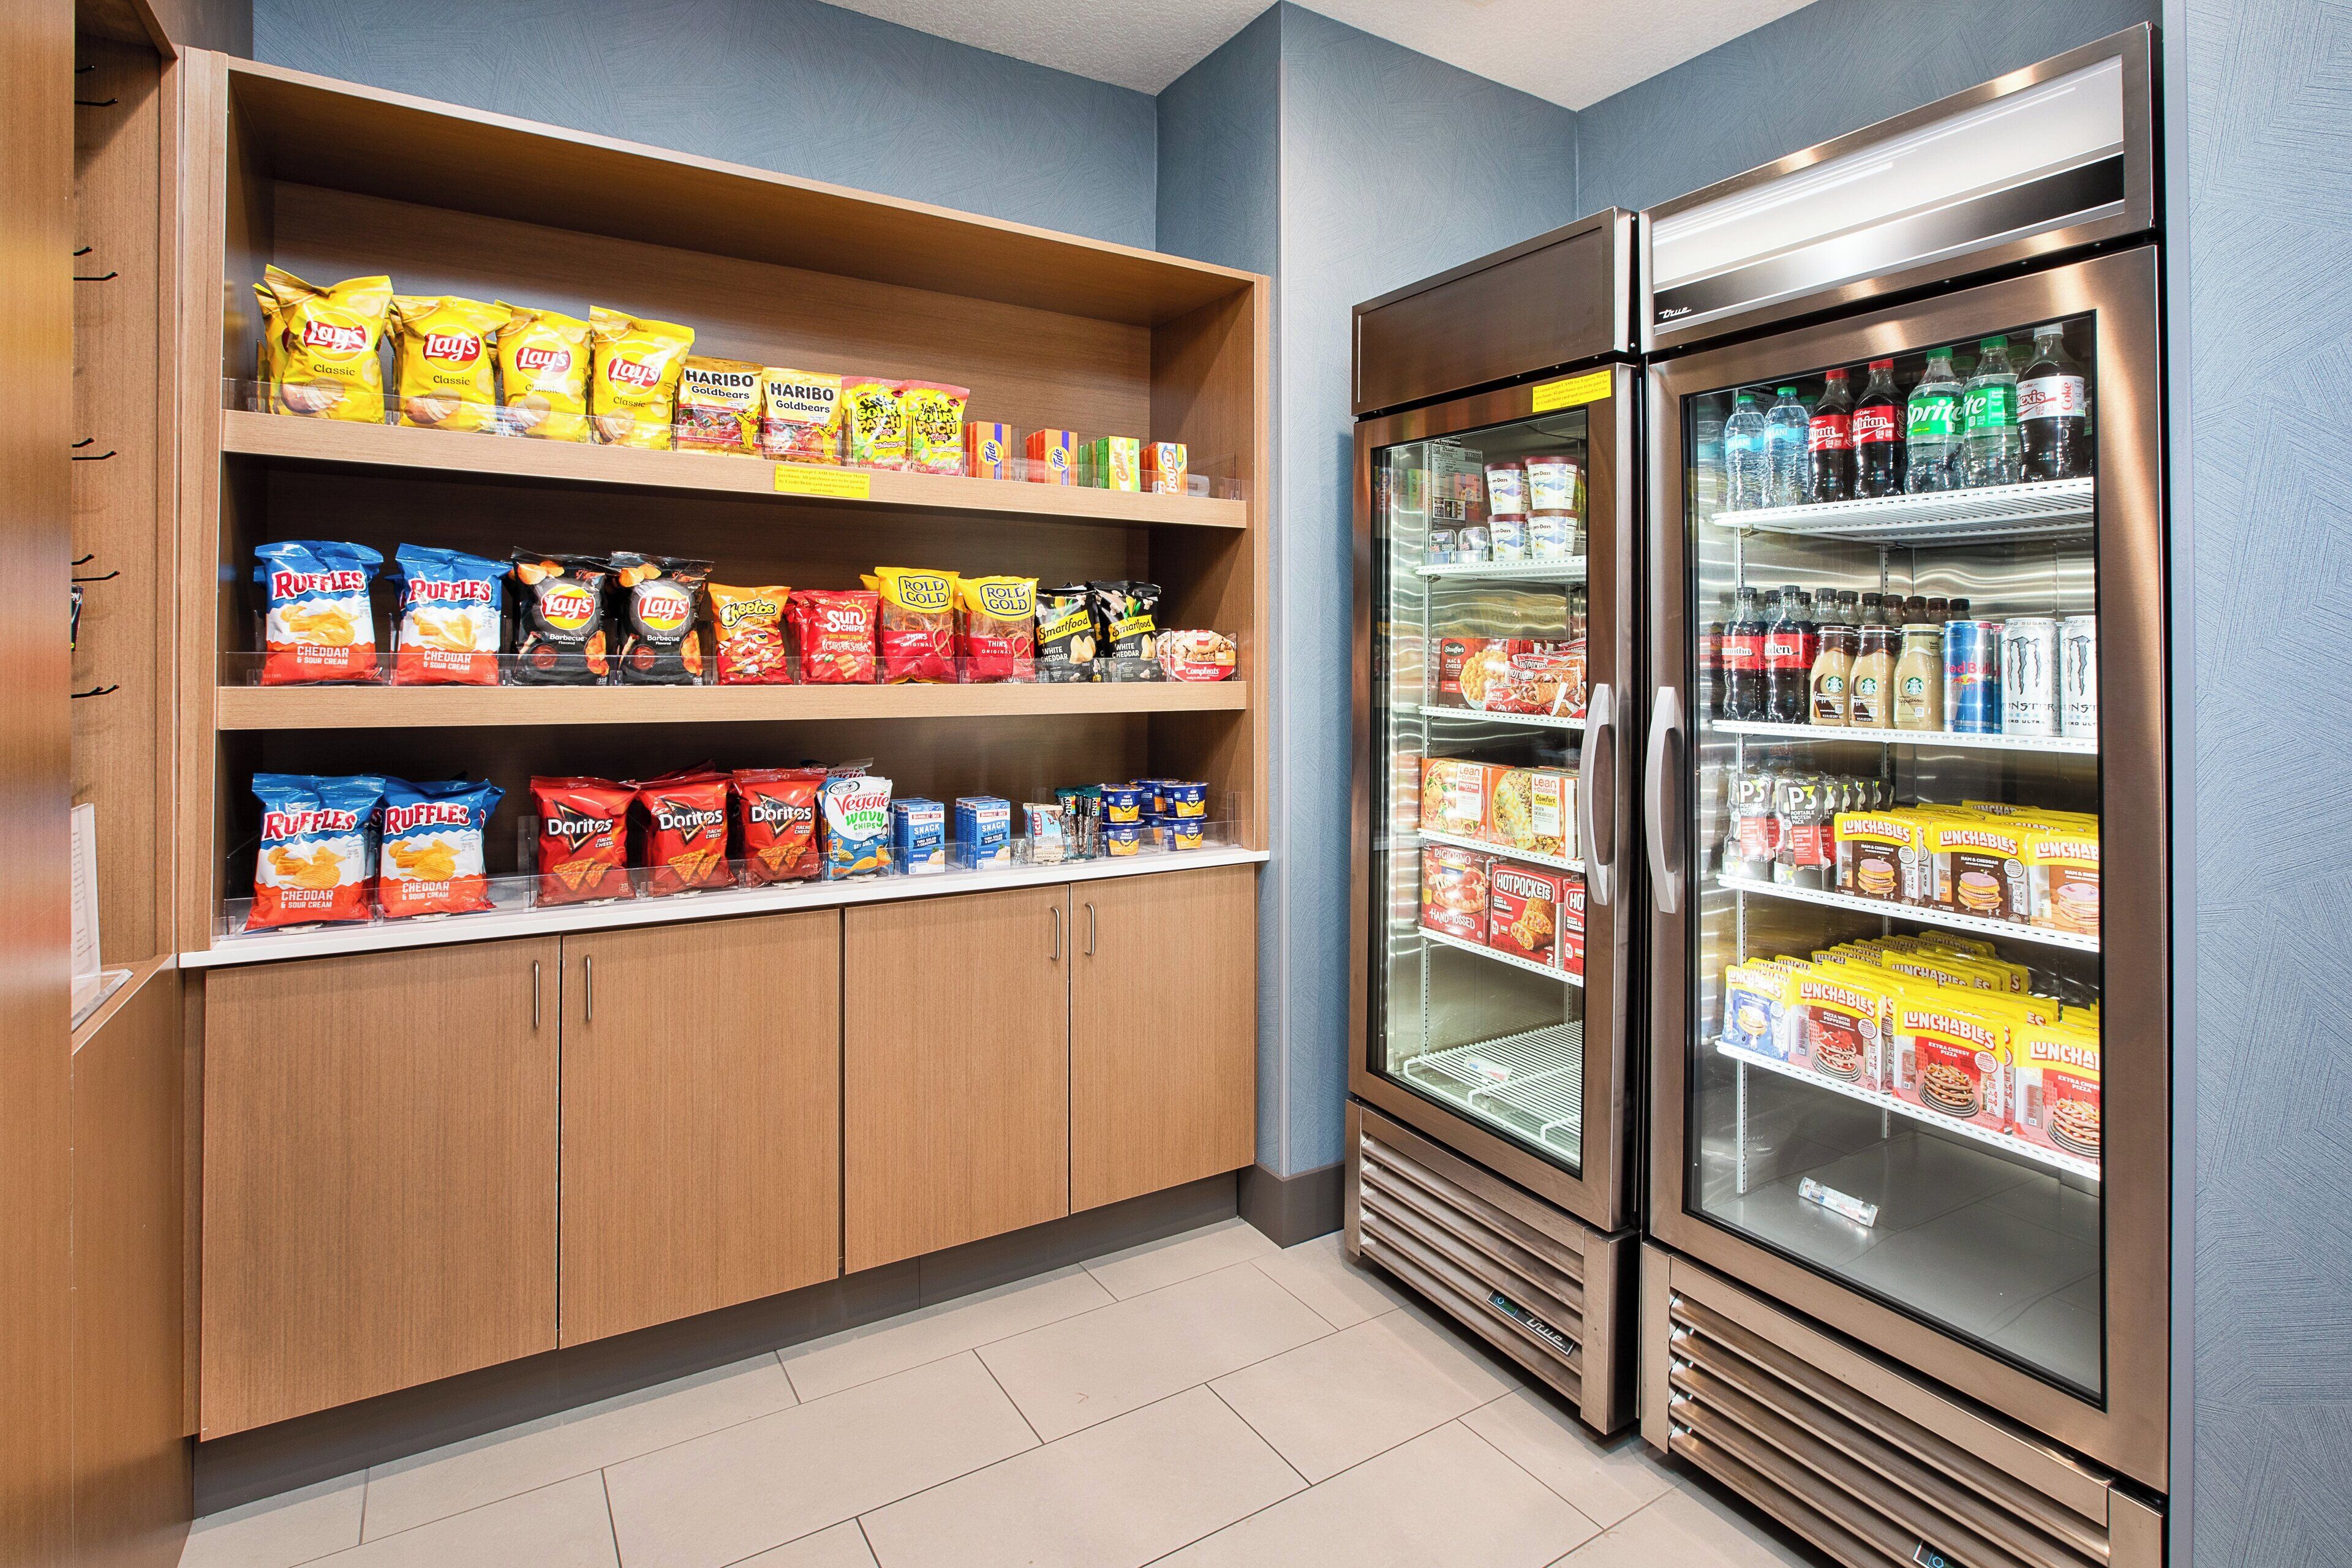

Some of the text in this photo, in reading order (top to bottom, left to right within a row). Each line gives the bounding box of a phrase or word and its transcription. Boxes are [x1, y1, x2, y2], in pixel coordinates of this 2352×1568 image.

[307, 321, 364, 350] Lay's
[426, 333, 477, 361] Lay's
[519, 347, 570, 372] Lay's
[314, 364, 355, 377] Classic
[433, 375, 470, 386] Classic
[686, 370, 754, 387] HARIBO
[525, 383, 561, 394] Classic
[692, 385, 750, 399] Goldbears
[771, 383, 834, 401] HARIBO
[613, 396, 646, 407] Classic
[2061, 382, 2072, 410] Coke
[776, 400, 830, 413] Goldbears
[857, 405, 897, 421] SOUR
[1908, 399, 1962, 427] Sprite
[918, 412, 955, 423] SOUR
[858, 417, 901, 434] PATCH
[916, 421, 957, 434] PATCH
[985, 441, 1000, 462] Tide
[1054, 448, 1066, 470] Tide
[1114, 451, 1129, 481] GAIN
[275, 571, 366, 598] RUFFLES
[410, 579, 491, 601] RUFFLES
[905, 579, 944, 592] ROLD
[906, 591, 946, 604] GOLD
[987, 586, 1025, 599] ROLD
[547, 596, 592, 619] Lay's
[642, 594, 688, 620] Lay's
[989, 598, 1028, 611] GOLD
[720, 599, 776, 627] Cheetos
[826, 610, 867, 632] Sun
[1039, 617, 1088, 641] Smartfood
[1112, 619, 1152, 638] Smartfood
[549, 633, 584, 642] Barbecue
[297, 646, 350, 657] CHEDDAR
[424, 650, 472, 663] CHEDDAR
[1042, 646, 1063, 655] WHITE
[1112, 650, 1140, 659] CHEDDAR
[1444, 645, 1465, 655] Stouffer's
[324, 657, 348, 666] CREAM
[1041, 653, 1069, 663] CHEDDAR
[1186, 667, 1219, 677] Compleats
[1944, 662, 1992, 674] Red Bull
[1460, 766, 1480, 777] Lean
[1534, 777, 1557, 788] Lean
[1536, 794, 1556, 804] Comfort
[1740, 780, 1765, 804] P3
[1788, 785, 1817, 811] P3
[834, 794, 889, 816] Veggie
[386, 804, 468, 834] RUFFLES
[660, 809, 723, 829] Doritos
[752, 806, 812, 822] Doritos
[845, 811, 884, 827] wavy
[265, 810, 356, 840] RUFFLES
[548, 819, 613, 835] Doritos
[914, 824, 940, 835] SNACK
[982, 821, 1006, 832] SNACK
[1843, 820, 1911, 843] LUNCHABLES
[1940, 830, 2019, 856] LUNCHABLES
[402, 882, 450, 892] CHEDDAR
[281, 891, 334, 902] CHEDDAR
[1429, 908, 1476, 930] HAND-TOSSED
[1547, 952, 1553, 963] 2
[1800, 981, 1875, 1019] LUNCHABLES
[1823, 1011, 1837, 1019] PIZZA
[1823, 1017, 1850, 1027] PEPPERONI
[1904, 1011, 1997, 1051] LUNCHABLES
[1928, 1042, 1970, 1057] EXTRA CHEESY
[1940, 1049, 1958, 1058] PIZZA
[2057, 1075, 2080, 1085] EXTRA
[2072, 1084, 2092, 1094] PIZZA
